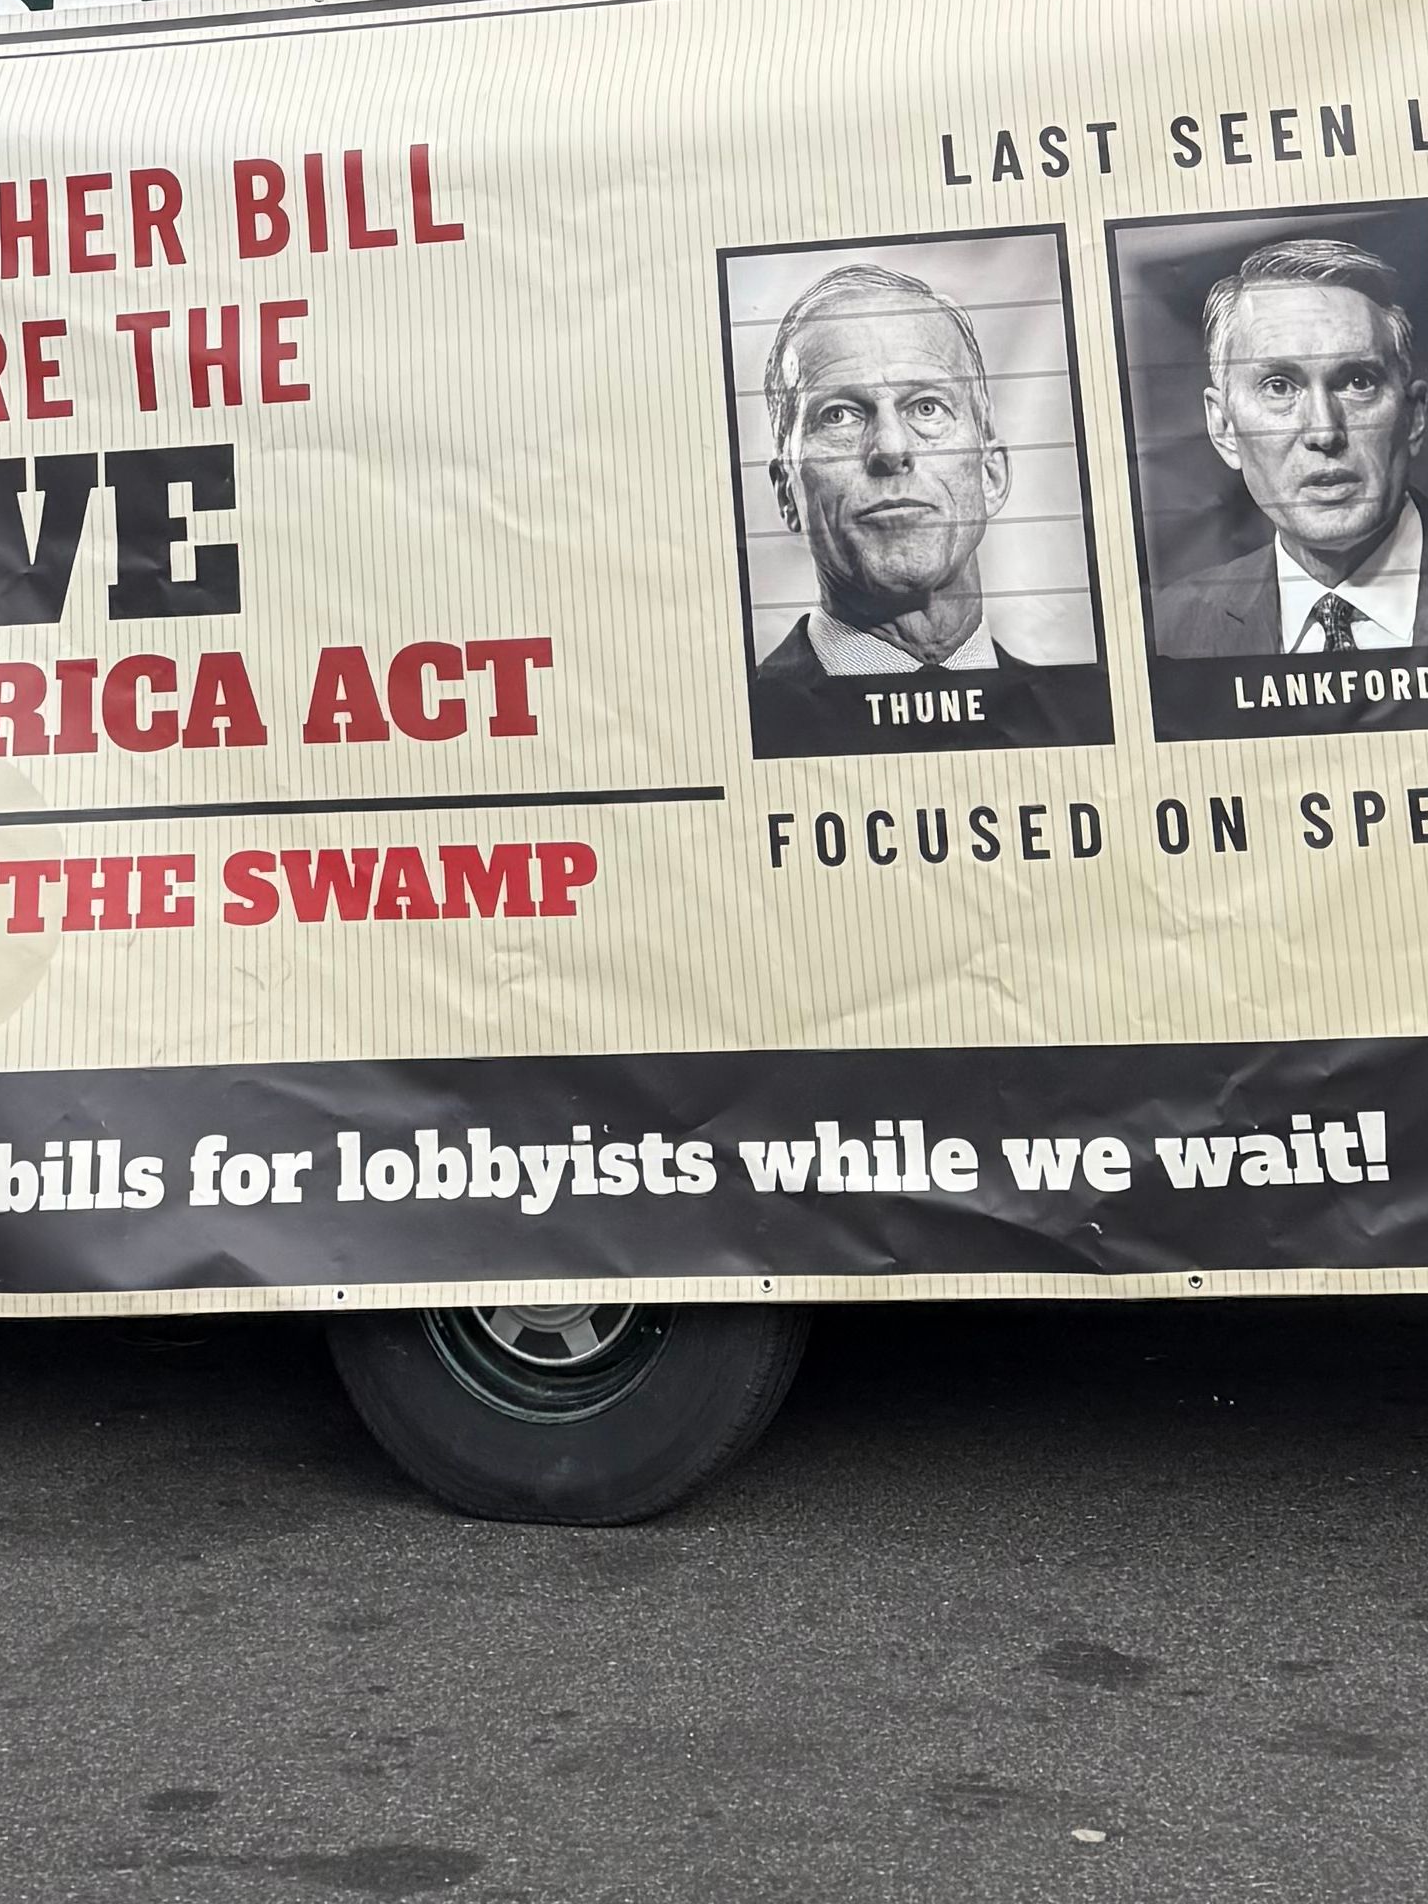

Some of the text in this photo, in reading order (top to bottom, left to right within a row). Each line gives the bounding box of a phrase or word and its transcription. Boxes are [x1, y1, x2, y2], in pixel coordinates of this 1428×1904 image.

[943, 122, 1116, 185] LAST
[1171, 105, 1356, 167] SEEN
[234, 145, 463, 258] BILL
[117, 301, 309, 410] THE
[304, 638, 551, 744] ACT
[866, 690, 984, 724] THUNE
[768, 804, 1101, 868] FOCUSED
[1157, 797, 1247, 854] ON
[223, 843, 597, 926] SWAMP
[190, 1135, 312, 1206] for
[337, 1125, 716, 1214] lobbyists
[739, 1120, 978, 1192] while
[1002, 1137, 1130, 1191] we
[1155, 1111, 1389, 1188] wait!
